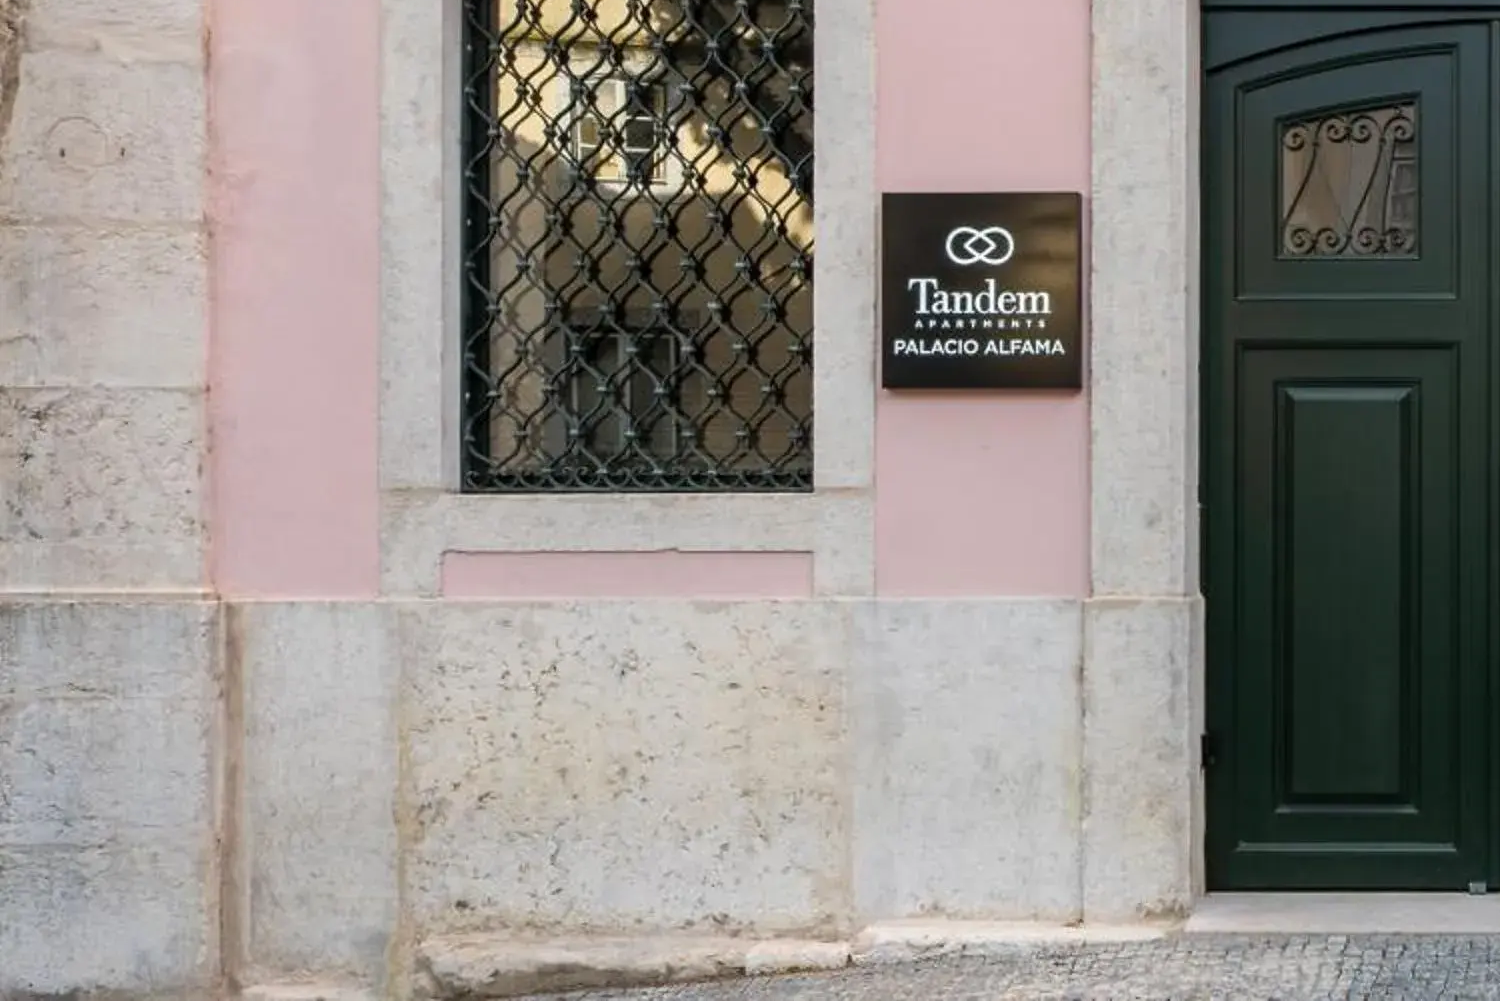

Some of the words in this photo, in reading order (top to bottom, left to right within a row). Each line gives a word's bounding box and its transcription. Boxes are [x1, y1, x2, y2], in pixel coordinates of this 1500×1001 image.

[907, 278, 1052, 315] Tandem
[914, 318, 1046, 329] APARTMENTS
[893, 339, 979, 356] PALACIO
[984, 339, 1066, 356] ALFAMA
